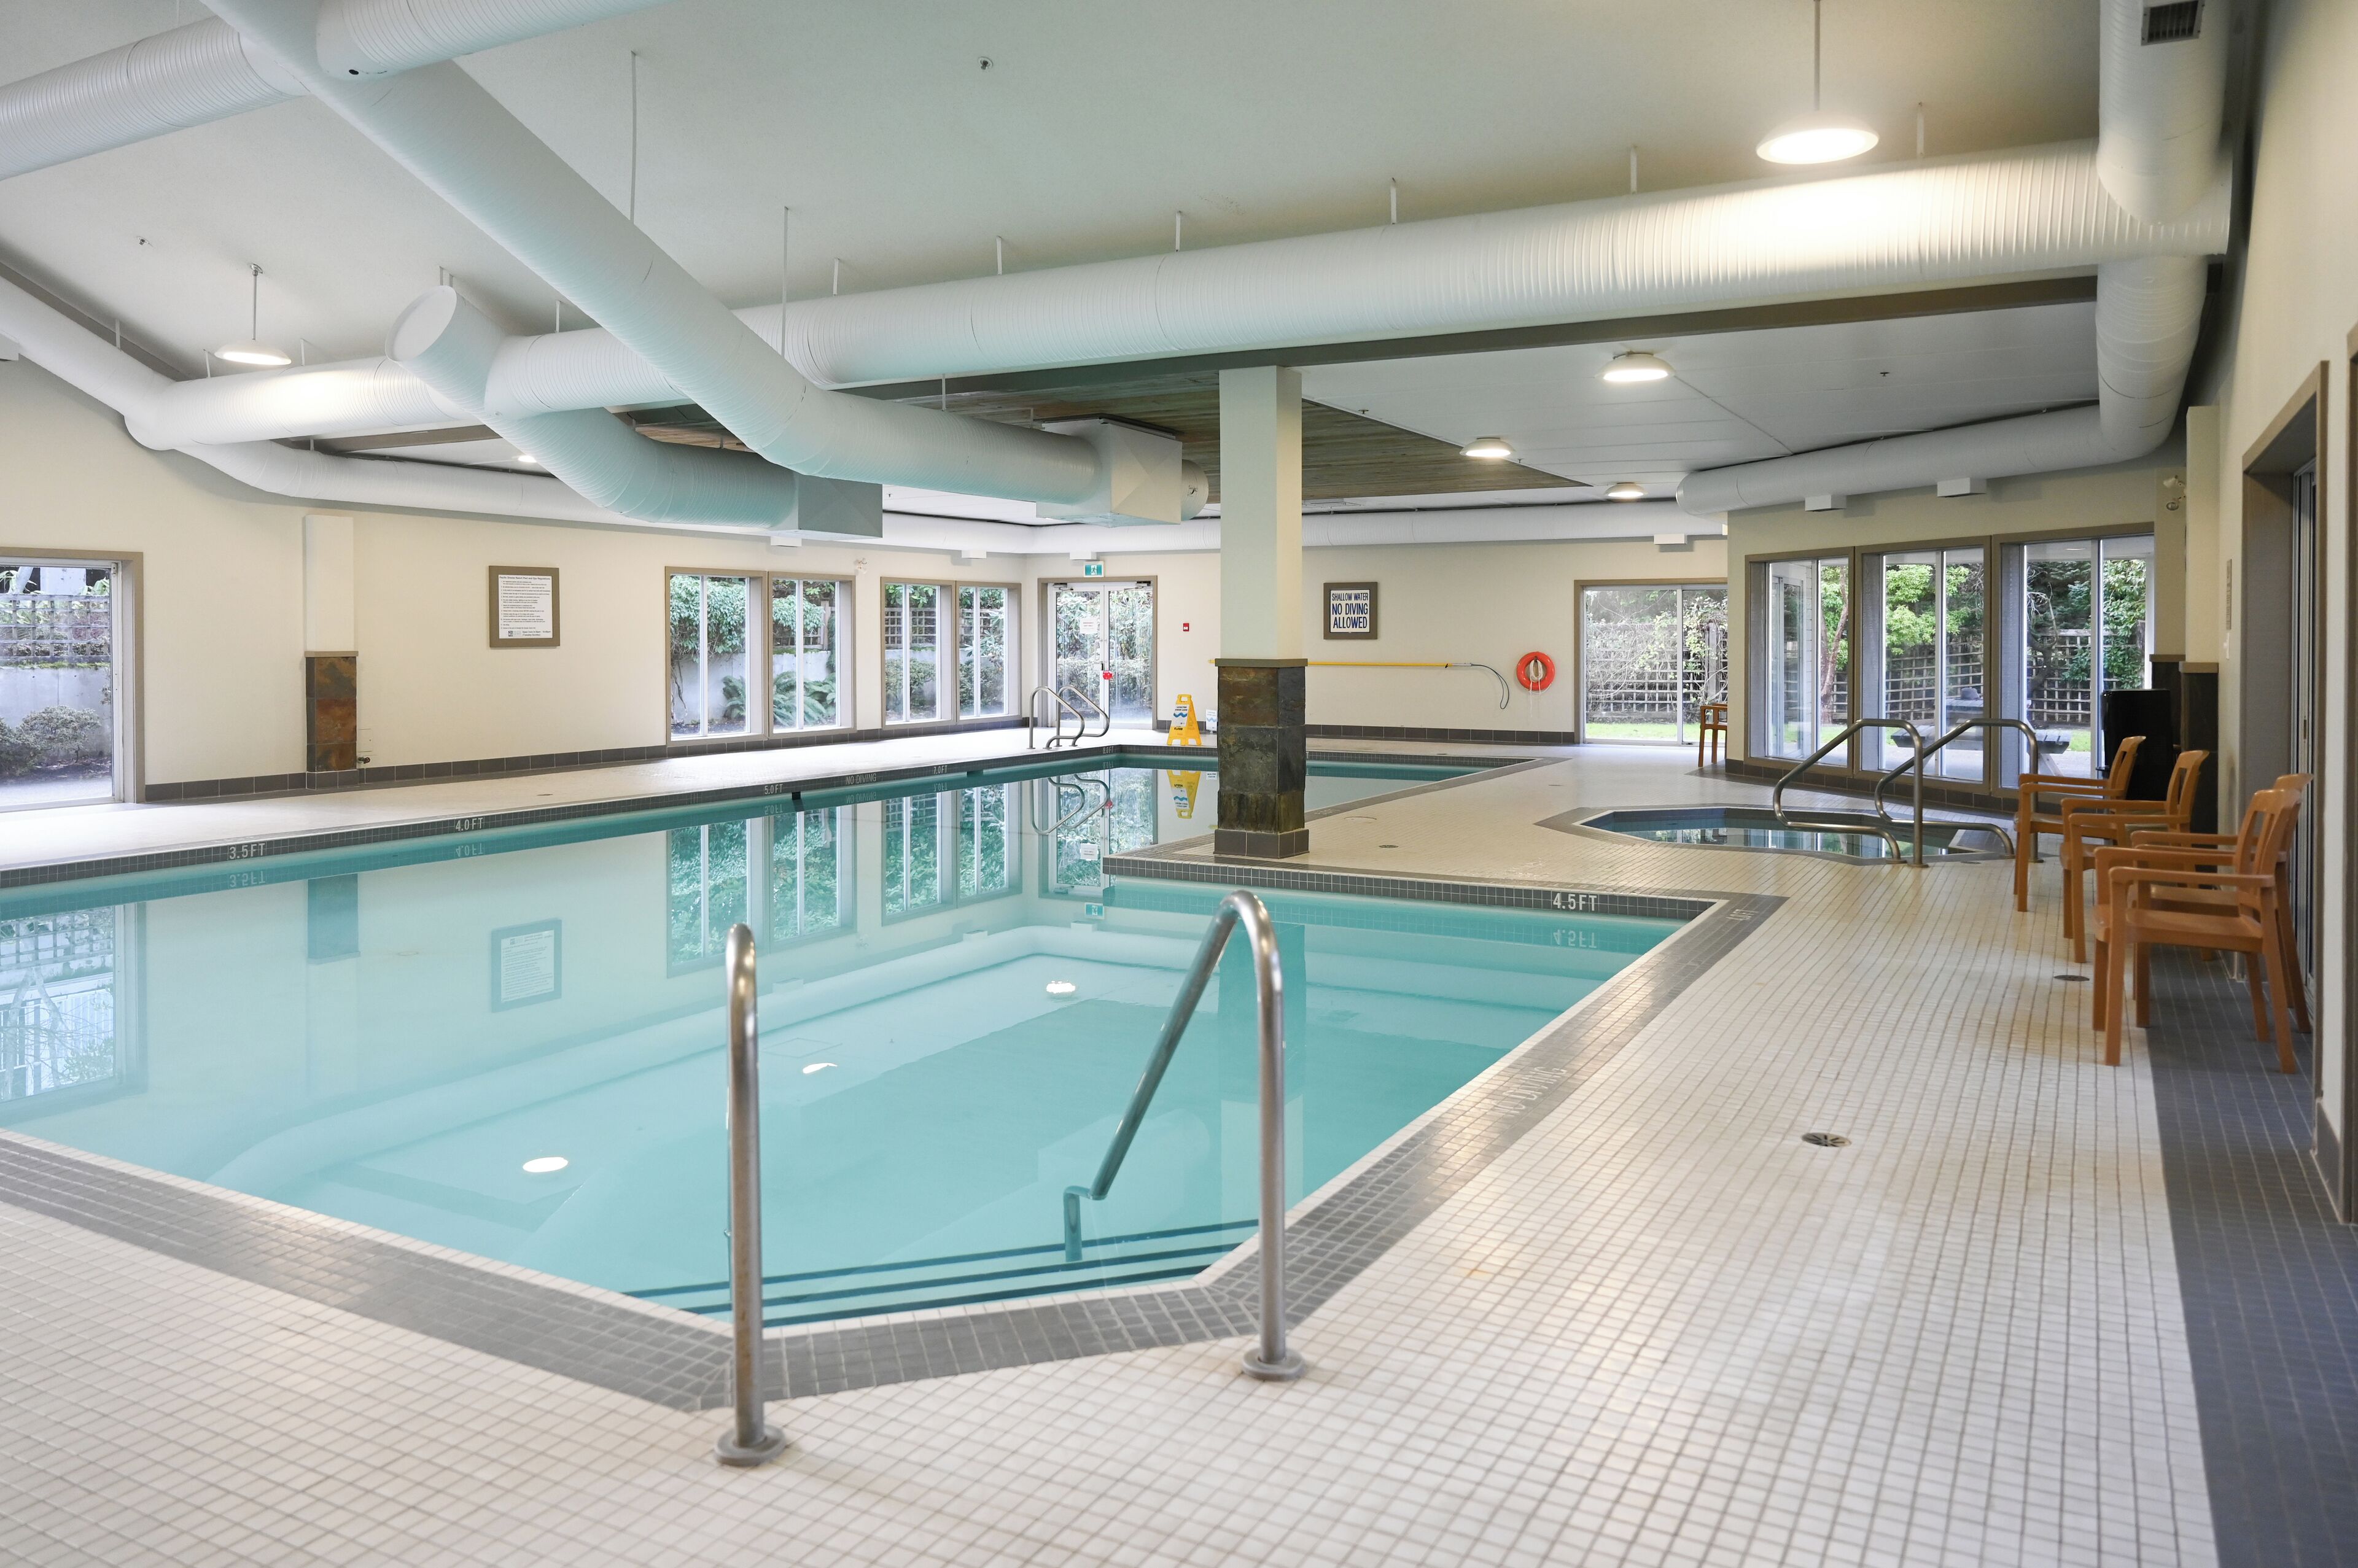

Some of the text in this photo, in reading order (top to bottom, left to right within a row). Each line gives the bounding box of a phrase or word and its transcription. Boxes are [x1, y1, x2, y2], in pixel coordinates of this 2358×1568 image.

[1333, 603, 1368, 615] NO DIVING
[1333, 616, 1367, 628] ALLOWED
[846, 774, 876, 785] NO DIVING
[1553, 893, 1597, 911] 4.5FT
[1490, 1066, 1567, 1117] NO DIVING
